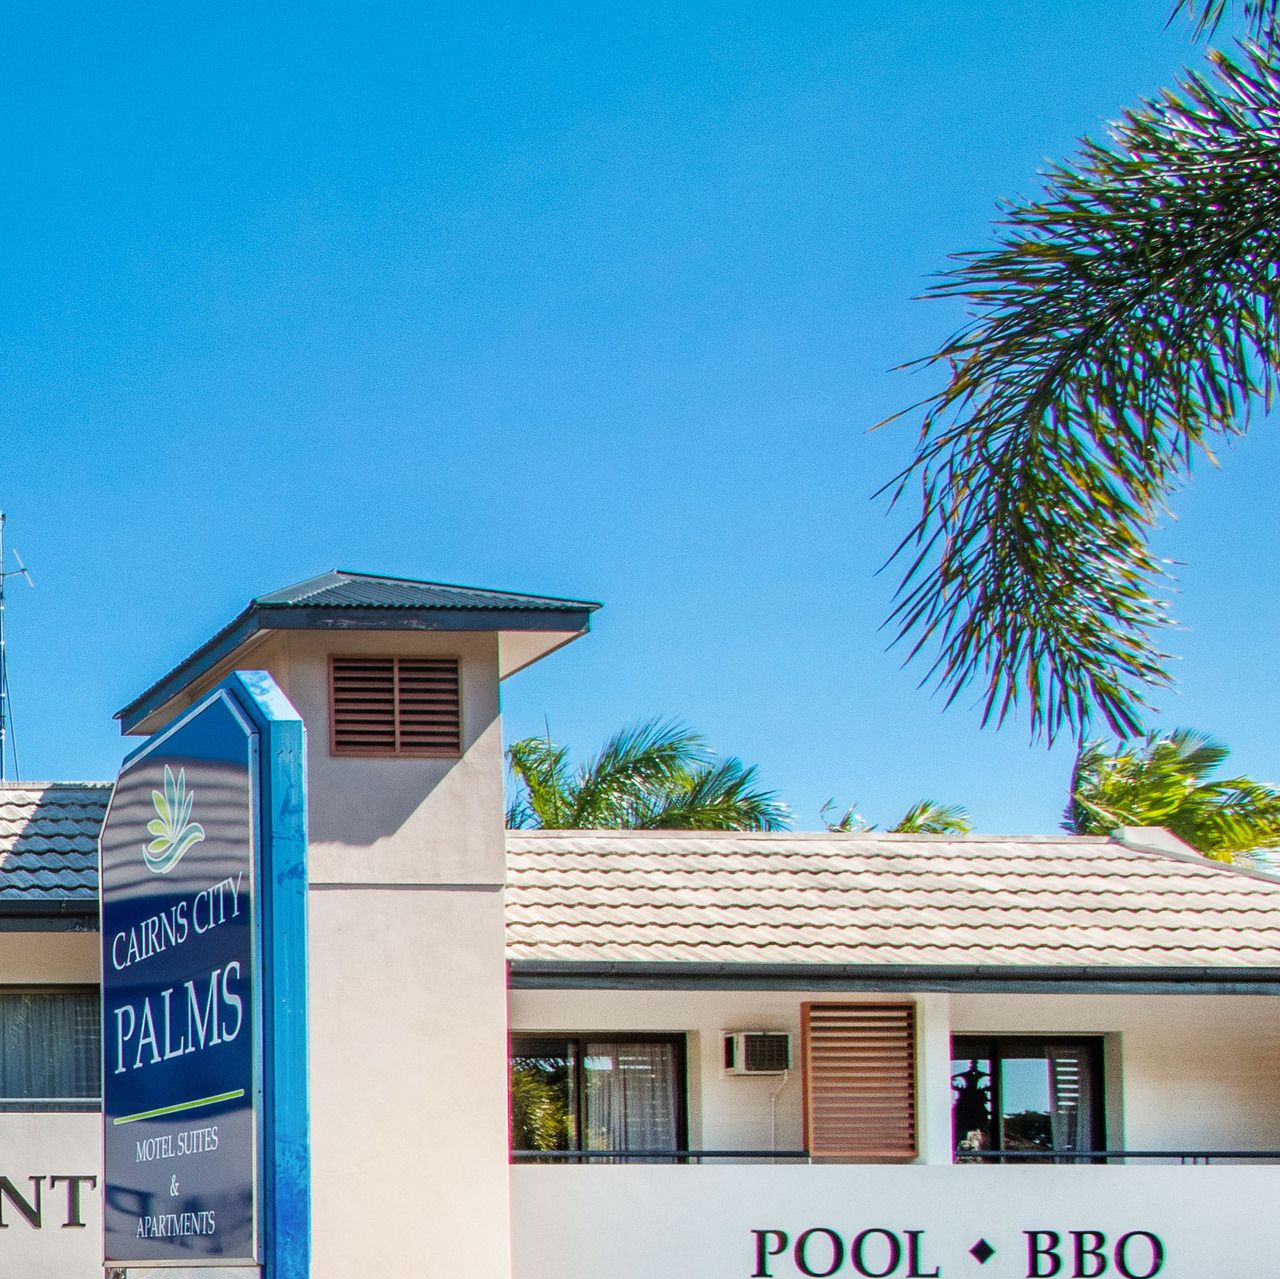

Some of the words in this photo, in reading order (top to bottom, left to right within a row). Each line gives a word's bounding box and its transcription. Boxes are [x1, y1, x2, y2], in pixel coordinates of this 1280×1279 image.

[111, 901, 188, 971] CAIRNS
[192, 871, 244, 934] CITY
[114, 960, 244, 1075] PALMS
[135, 1135, 176, 1163] MOTEL
[177, 1126, 219, 1156] SUITES
[169, 1174, 180, 1197] &
[136, 1210, 215, 1239] APARTMENTS
[750, 1228, 940, 1279] POOL
